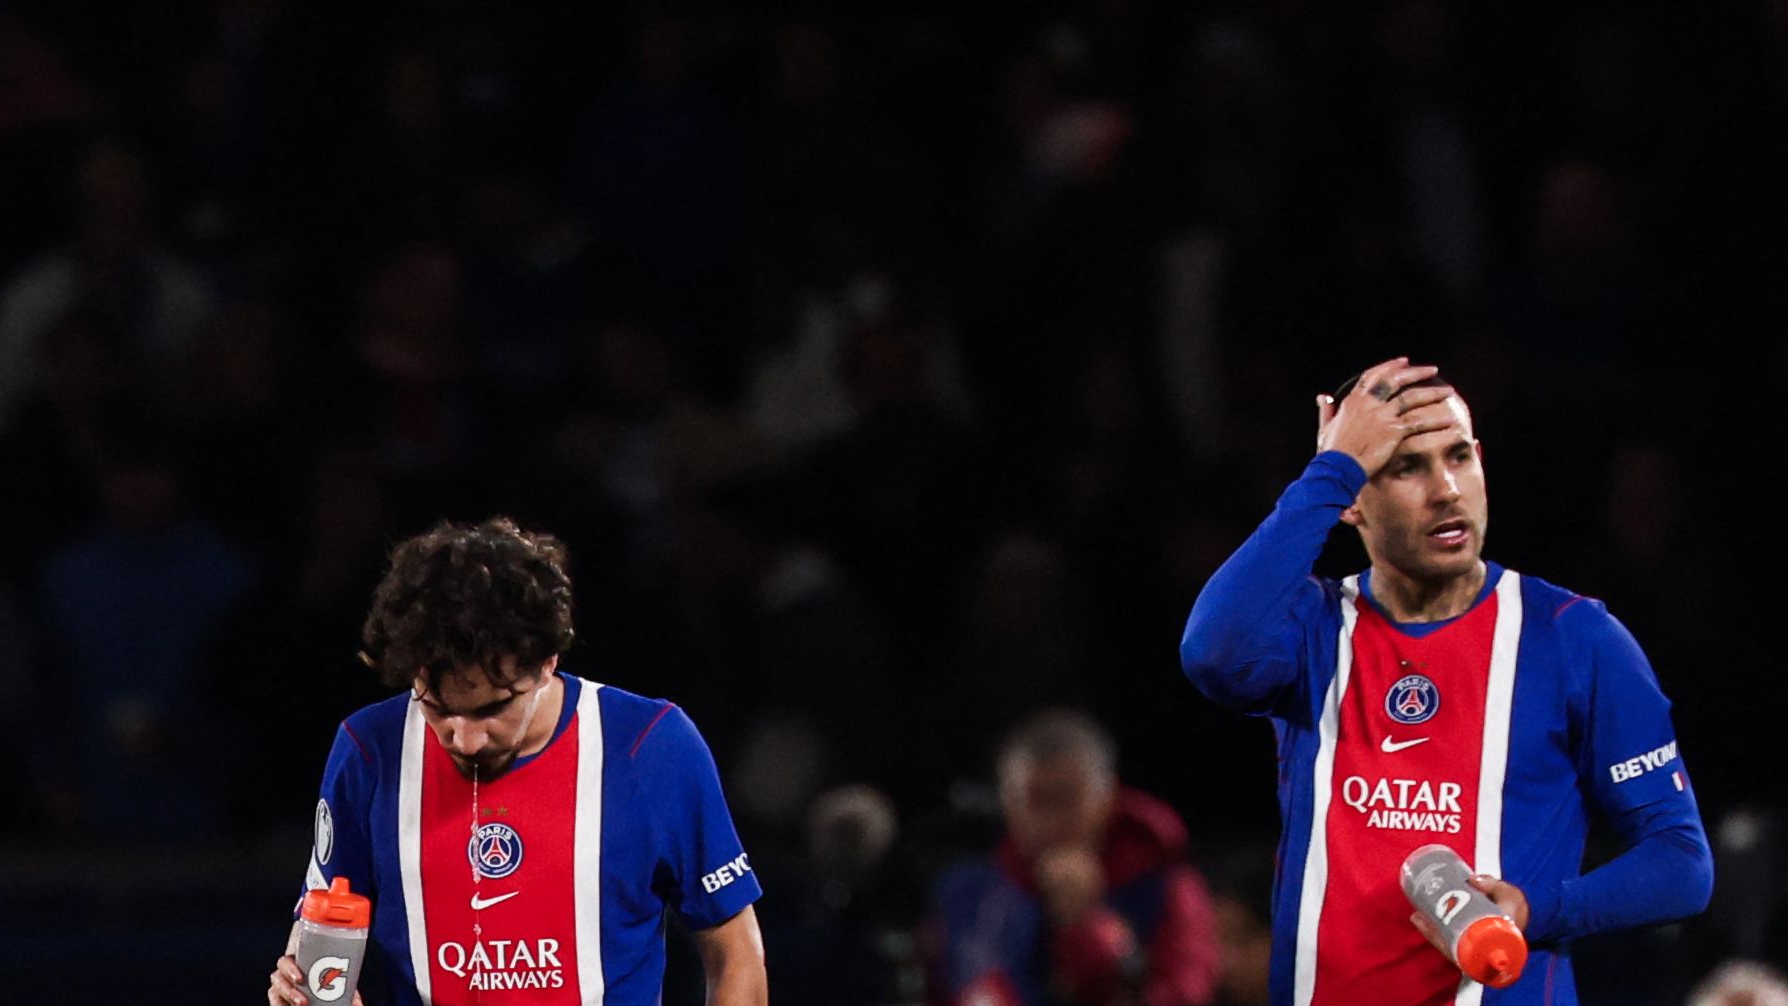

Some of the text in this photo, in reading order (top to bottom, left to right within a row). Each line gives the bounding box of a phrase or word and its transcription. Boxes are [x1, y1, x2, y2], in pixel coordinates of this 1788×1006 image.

[1343, 776, 1462, 813] QATAR
[478, 826, 513, 841] PARIS
[1366, 810, 1462, 834] AIRWAYS
[438, 938, 562, 978] QATAR
[308, 956, 350, 1002] G
[469, 969, 564, 991] AIRWAYS
